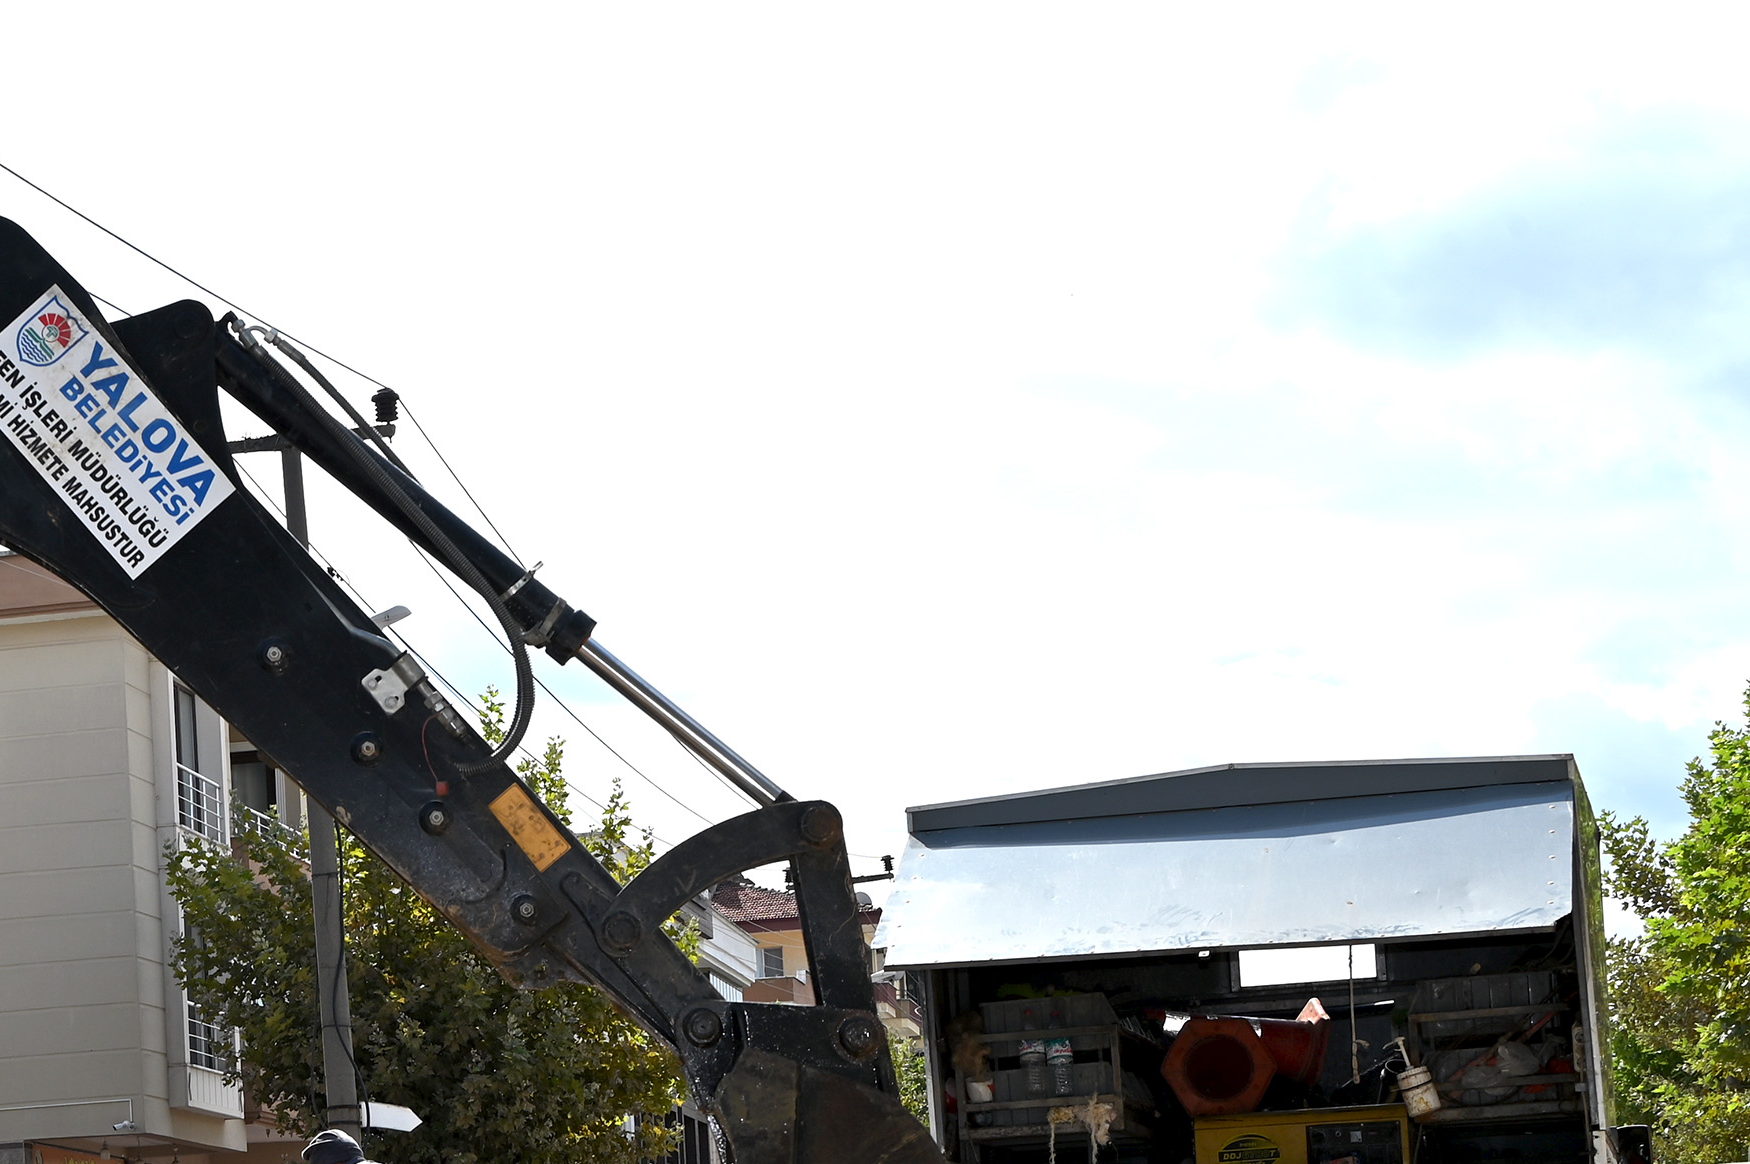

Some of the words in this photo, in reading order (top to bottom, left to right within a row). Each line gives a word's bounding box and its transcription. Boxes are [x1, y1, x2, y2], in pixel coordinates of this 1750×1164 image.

[7, 413, 67, 482] HİZMETE
[62, 474, 146, 569] MAHSUSTUR
[19, 382, 78, 442] İŞLERİ
[67, 439, 169, 549] MÜDÜRLÜĞÜ
[79, 341, 216, 507] YALOVA
